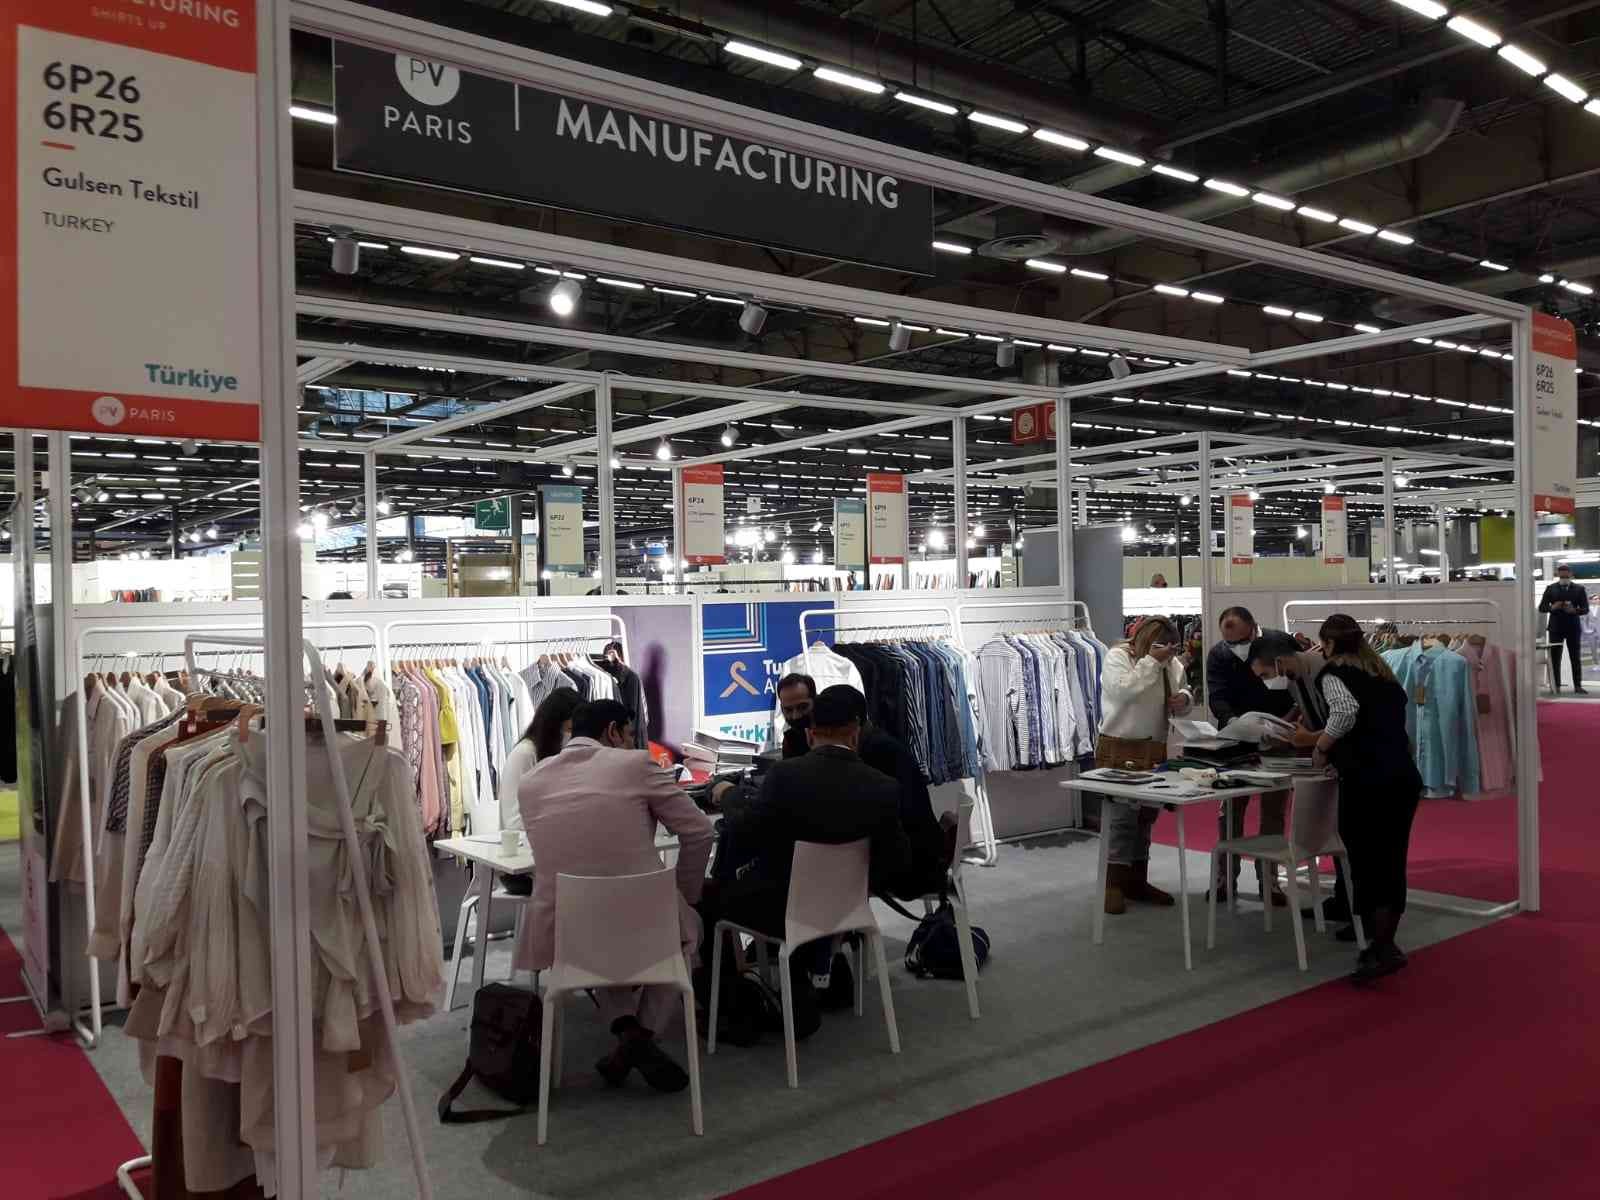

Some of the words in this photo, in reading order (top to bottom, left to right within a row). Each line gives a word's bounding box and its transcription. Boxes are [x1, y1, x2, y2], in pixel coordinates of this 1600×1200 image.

[43, 61, 141, 104] 6P26
[43, 101, 144, 143] 6R25
[383, 105, 473, 144] PARIS
[556, 98, 899, 209] MANUFACTURING
[42, 166, 123, 197] Gulsen
[129, 179, 200, 210] Tekstil
[42, 211, 115, 234] TURKEY
[144, 363, 238, 393] Türkiye
[129, 407, 176, 423] PARIS
